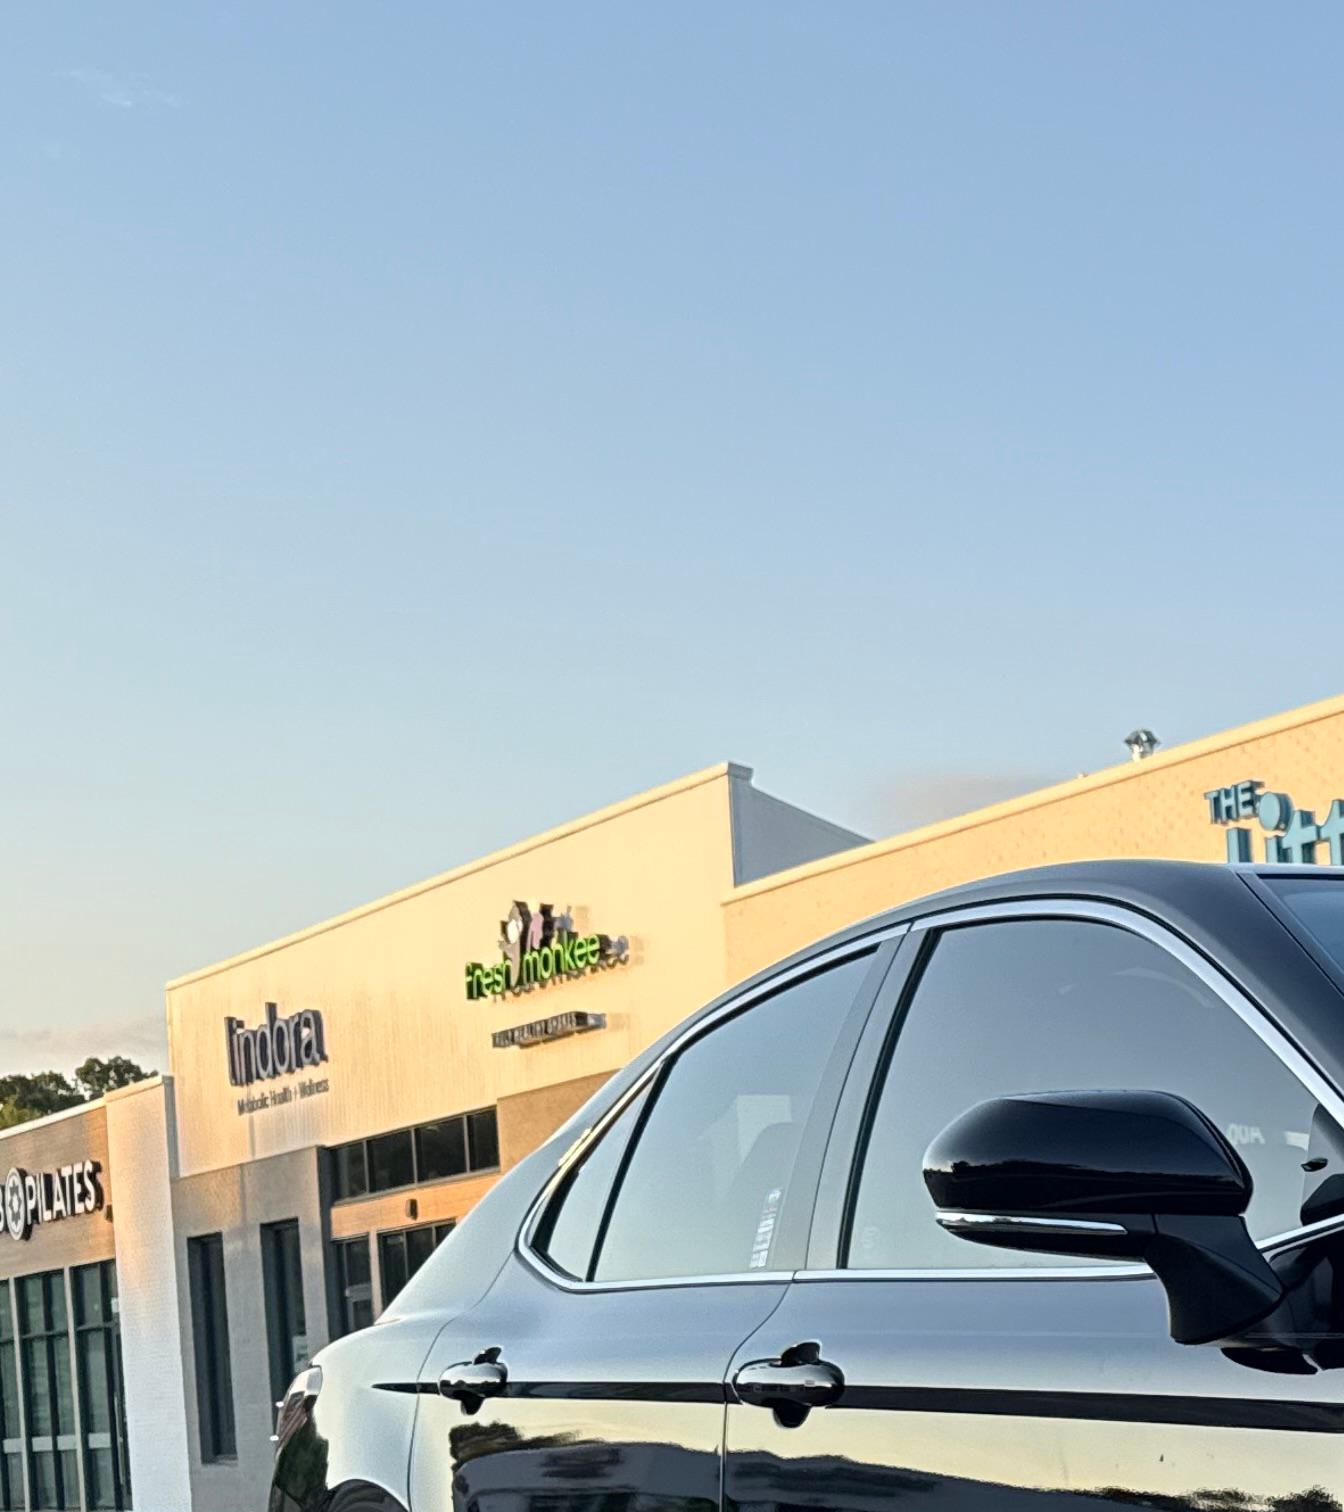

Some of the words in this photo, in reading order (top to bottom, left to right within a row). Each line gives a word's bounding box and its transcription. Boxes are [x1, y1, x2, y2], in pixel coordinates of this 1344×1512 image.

[1204, 780, 1262, 824] THE
[465, 960, 513, 999] fresh
[521, 929, 606, 986] monkee
[25, 1159, 104, 1226] PILATES
